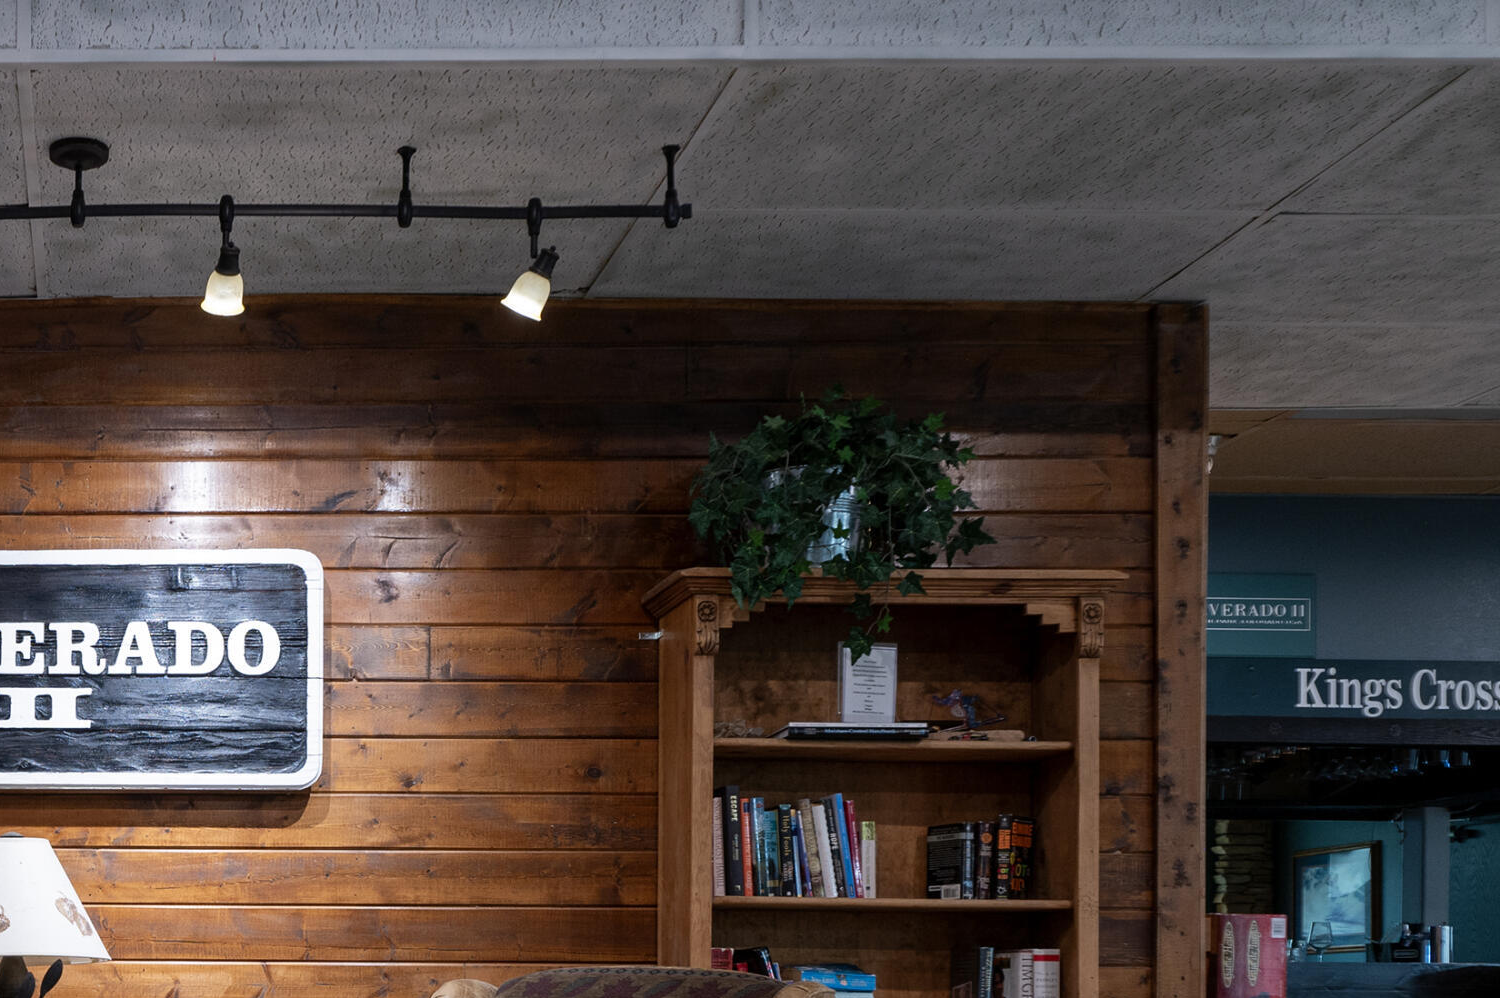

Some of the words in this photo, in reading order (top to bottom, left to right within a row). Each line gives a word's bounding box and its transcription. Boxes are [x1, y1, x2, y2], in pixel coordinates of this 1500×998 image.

[1294, 667, 1404, 718] Kings
[729, 795, 737, 821] ESCAPE
[779, 815, 790, 832] Holy
[782, 836, 792, 856] Fools
[1021, 954, 1033, 980] TIM
